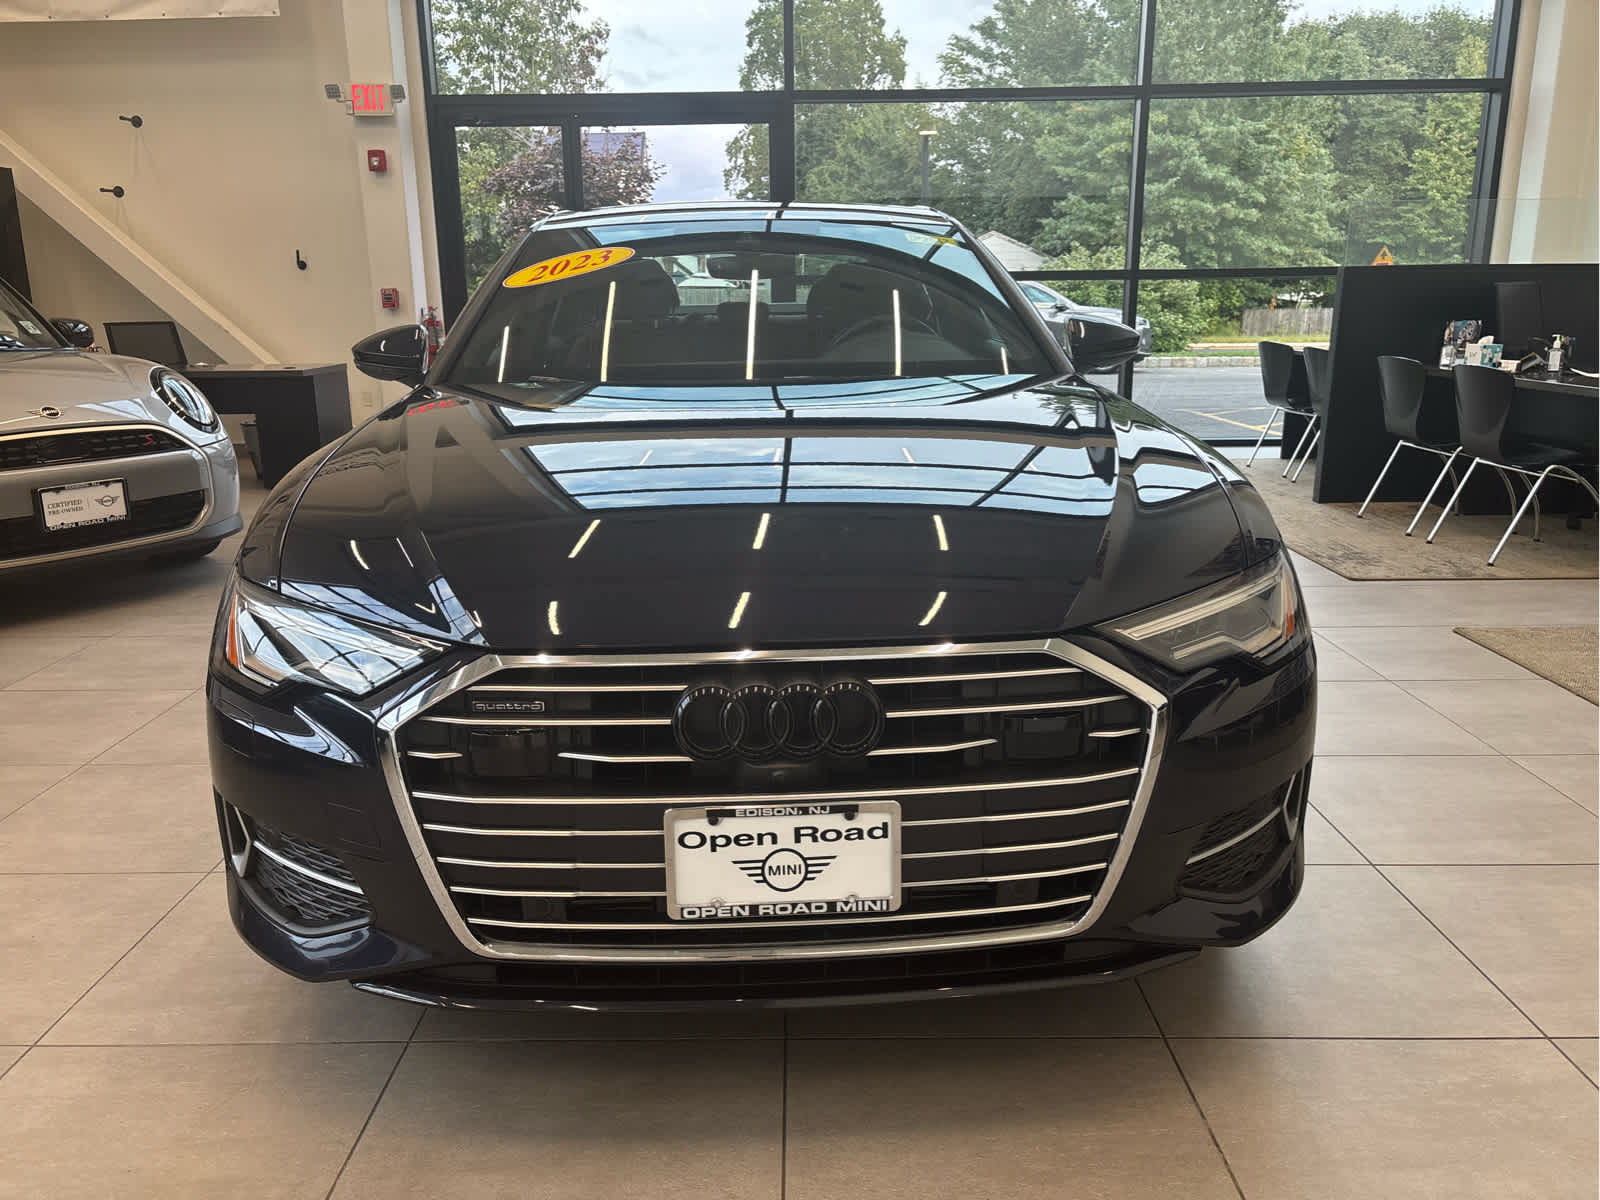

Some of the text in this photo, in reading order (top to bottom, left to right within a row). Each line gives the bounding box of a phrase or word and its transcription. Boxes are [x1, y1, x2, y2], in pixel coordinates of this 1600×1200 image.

[351, 84, 385, 111] EXIT
[527, 249, 613, 283] 2023
[143, 433, 153, 446] S
[47, 499, 82, 508] CERTIFIED
[49, 514, 126, 531] OPEN ROAD MINI
[475, 703, 542, 711] quattro
[809, 804, 831, 815] NJ
[677, 821, 889, 853] Open Road
[767, 864, 803, 876] MINI
[682, 898, 889, 919] OPEN ROAD MINI
